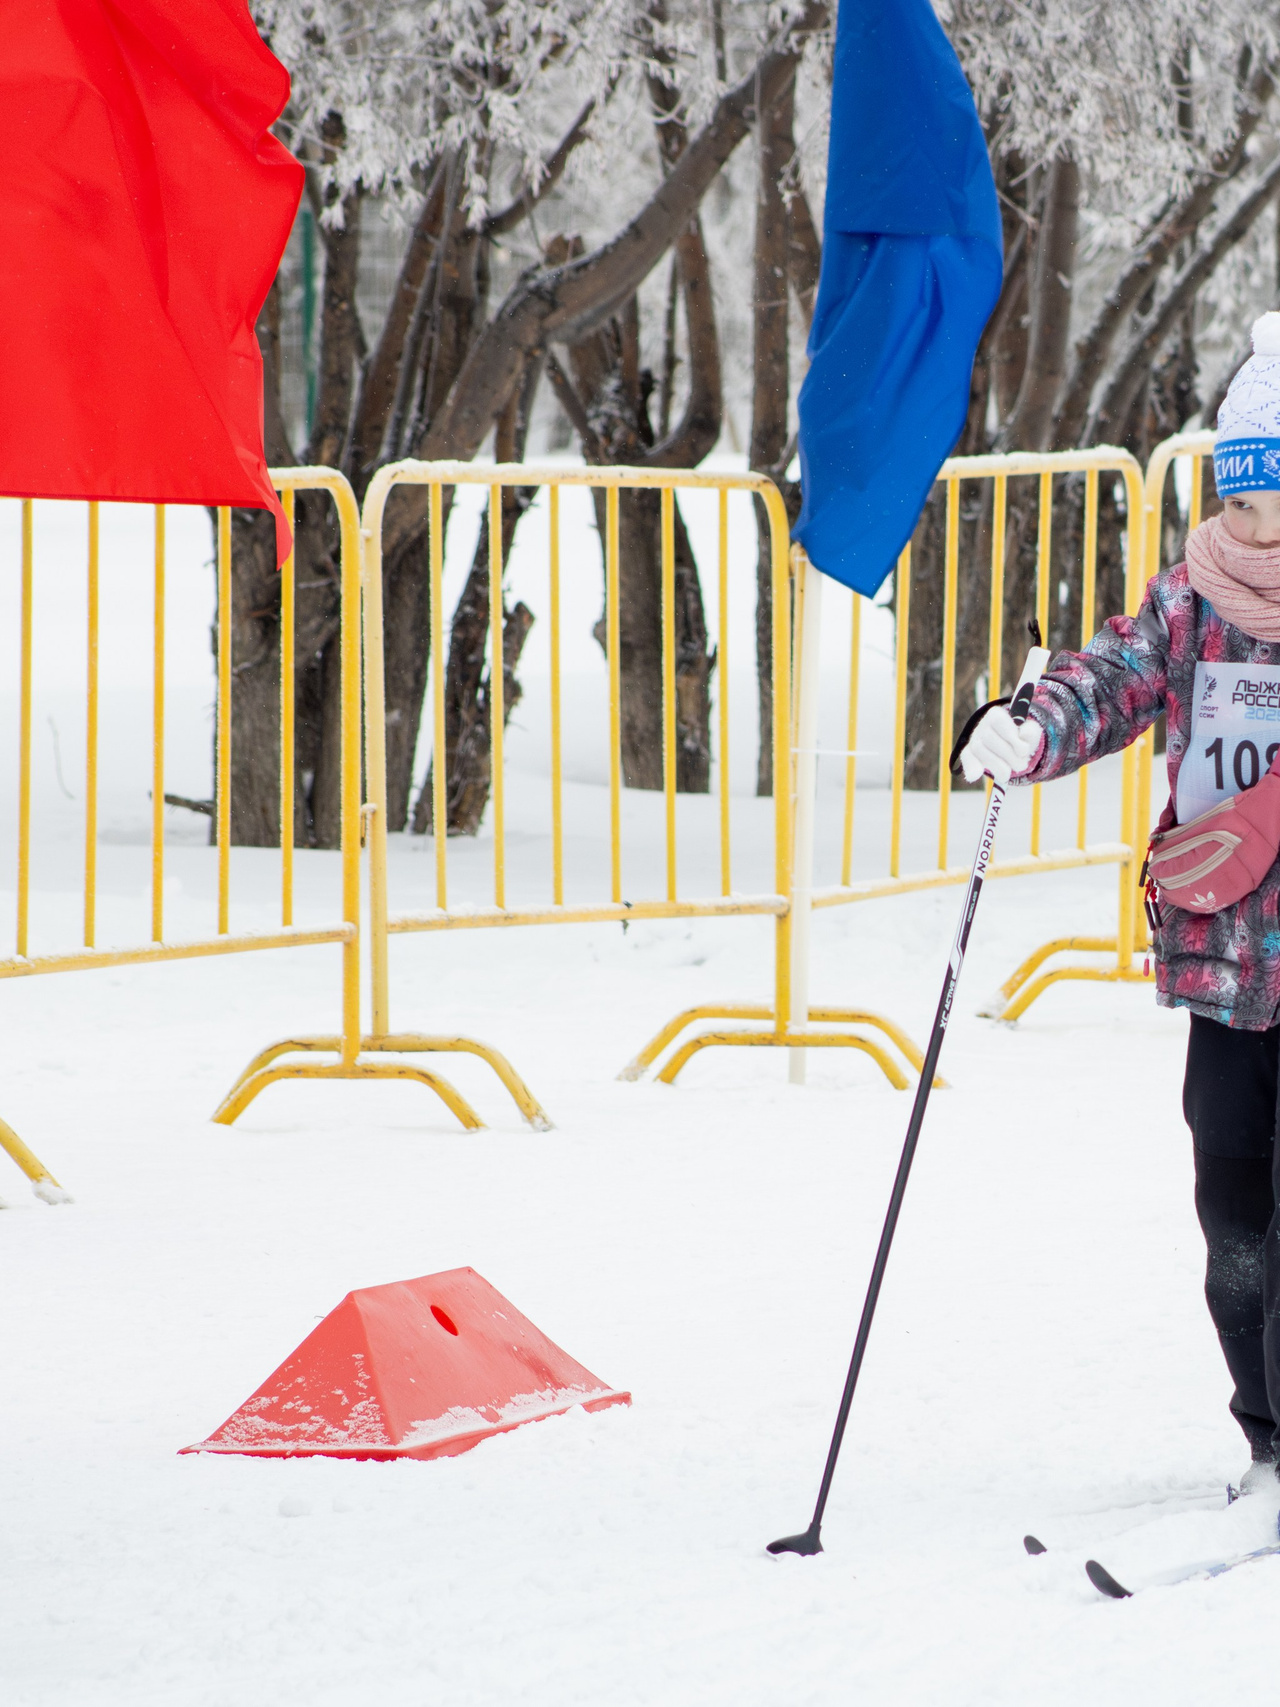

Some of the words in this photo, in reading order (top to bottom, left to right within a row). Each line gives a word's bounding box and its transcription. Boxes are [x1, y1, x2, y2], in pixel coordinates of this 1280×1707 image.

[976, 794, 1003, 874] NORDWAY
[943, 979, 957, 1011] ACTIVE
[939, 1010, 950, 1030] XC
